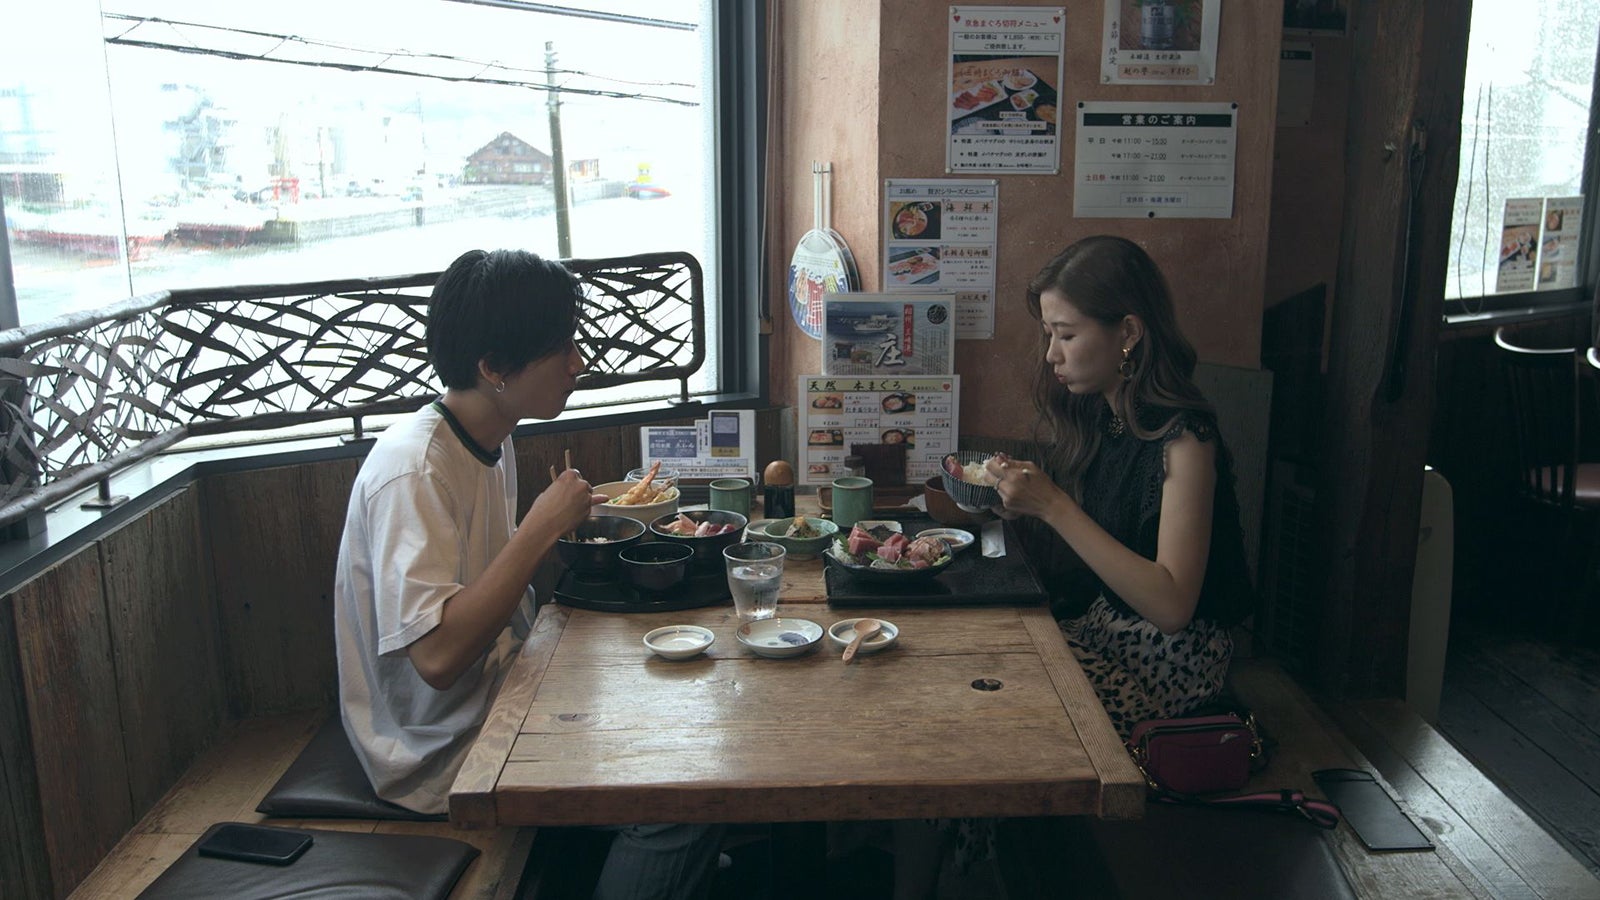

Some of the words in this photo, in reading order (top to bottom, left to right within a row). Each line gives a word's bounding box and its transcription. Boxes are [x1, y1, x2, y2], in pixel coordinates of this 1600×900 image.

[1121, 115, 1197, 126] 営業のご案内
[809, 380, 837, 391] 天然
[853, 380, 902, 391] 本まぐろ
